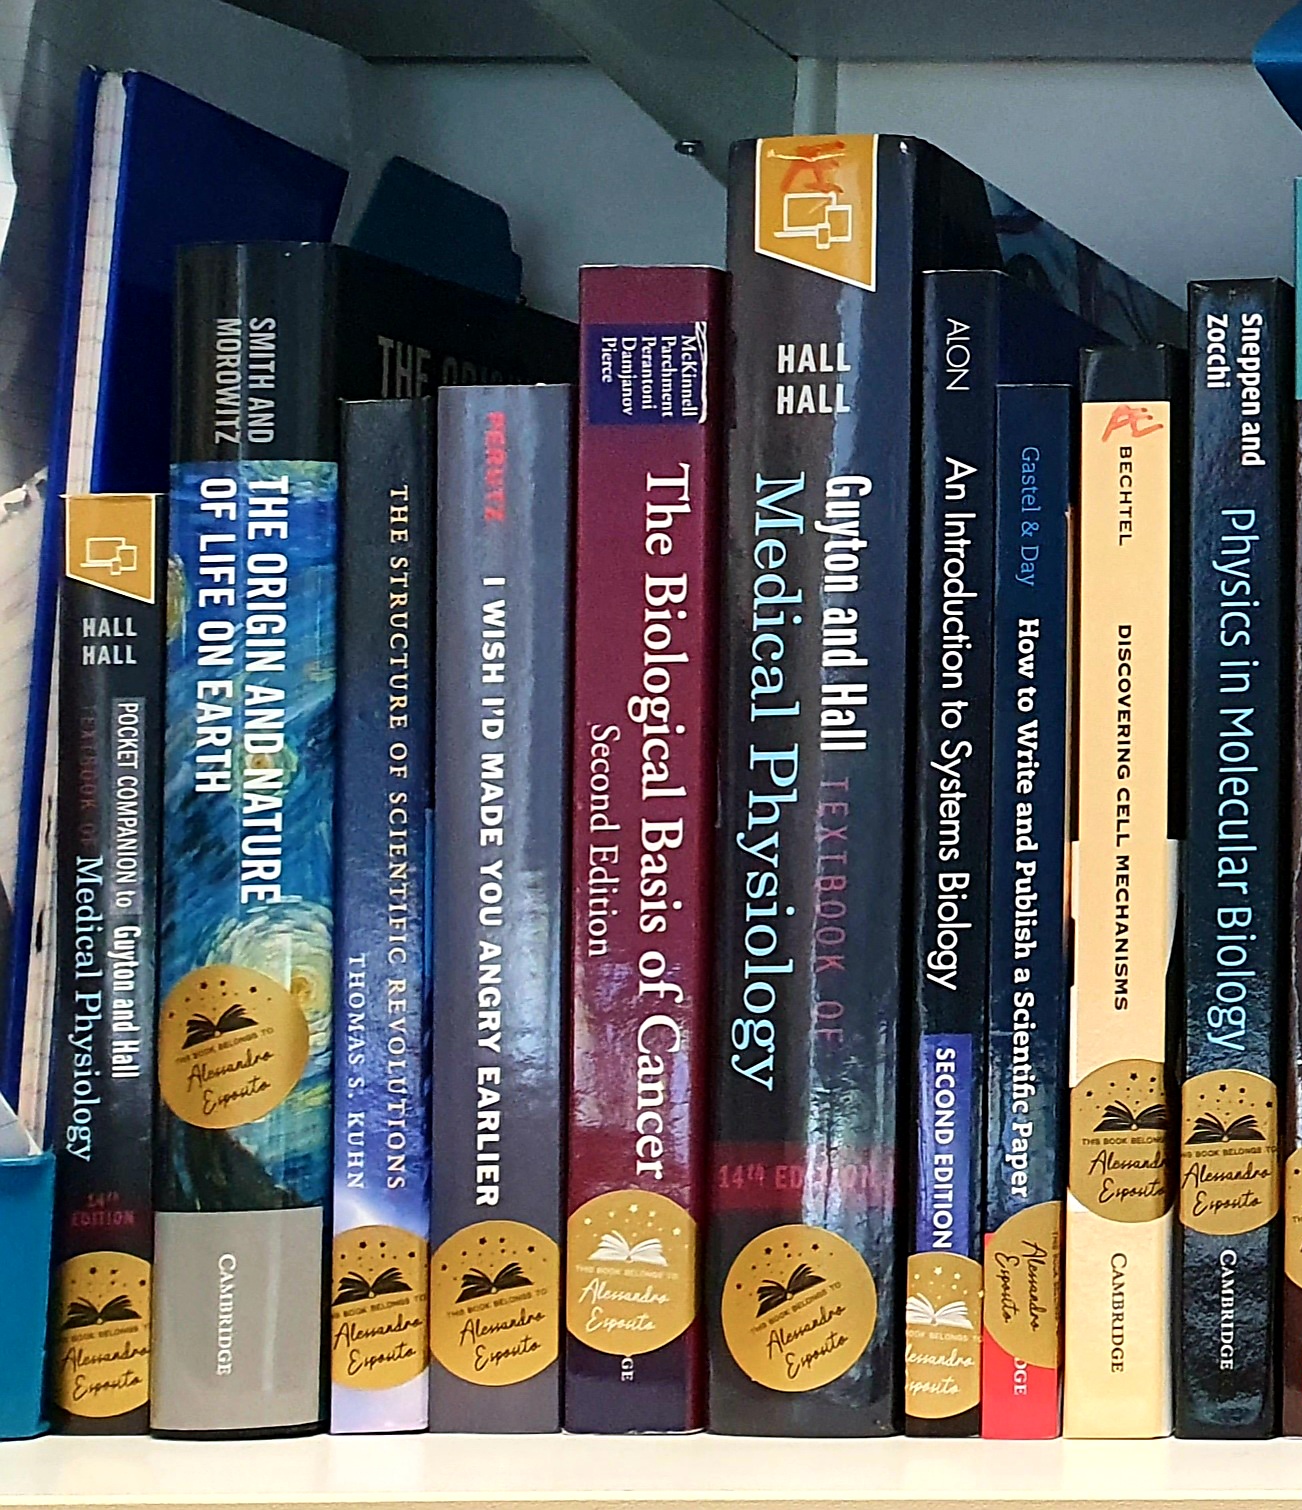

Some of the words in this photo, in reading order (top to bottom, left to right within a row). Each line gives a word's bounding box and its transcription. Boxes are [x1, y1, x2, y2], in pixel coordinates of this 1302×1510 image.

[214, 317, 241, 444] MOROWITZ
[249, 316, 275, 389] SMITH
[600, 337, 617, 383] Pierce
[617, 337, 638, 416] Damjanov
[641, 336, 656, 409] Perantoni
[661, 335, 677, 418] Parchment
[681, 334, 699, 417] McKinnell
[777, 343, 851, 373] HALL
[946, 318, 971, 392] ALON
[1205, 314, 1228, 389] Zocchi
[1238, 313, 1264, 415] Sneppen
[249, 394, 273, 443] AND
[776, 383, 851, 414] HALL
[1020, 446, 1041, 509] Gastel
[1240, 423, 1266, 465] and
[201, 476, 236, 524] OF
[246, 476, 288, 538] THE
[389, 484, 409, 543] THE
[813, 474, 872, 593] Guyton
[1020, 519, 1039, 536] &
[1117, 446, 1132, 547] BECHTEL
[198, 534, 235, 610] LIFE
[482, 577, 504, 586] I
[750, 472, 806, 723] Medical
[1019, 545, 1039, 588] Day
[1213, 509, 1258, 647] Physics
[82, 618, 137, 638] HALL
[197, 620, 234, 667] ON
[244, 546, 287, 671] ORIGIN
[389, 555, 408, 701] STRUCTURE
[481, 593, 505, 686] WISH
[821, 607, 869, 671] and
[82, 645, 137, 665] HALL
[1221, 659, 1258, 693] in
[116, 702, 138, 770] POCKET
[195, 680, 233, 793] EARTH
[244, 683, 285, 754] AND
[819, 681, 868, 752] Hall
[388, 741, 407, 780] OF
[115, 774, 138, 884] COMPANION
[241, 769, 284, 904] NATURE
[478, 751, 502, 848] MADE
[1215, 709, 1258, 896] Molecular
[116, 890, 133, 909] to
[386, 792, 408, 965] SCIENTIFIC
[477, 859, 502, 927] YOU
[74, 855, 104, 984] Medical
[730, 744, 798, 1091] Physiology
[107, 925, 141, 989] Guyton
[1207, 906, 1256, 1053] Biology
[112, 996, 140, 1034] and
[348, 953, 365, 1065] THOMAS
[477, 938, 501, 1054] ANGRY
[66, 990, 102, 1163] Physiology
[111, 1039, 140, 1079] Hall
[348, 1076, 365, 1098] S.
[386, 976, 406, 1189] REVOLUTIONS
[935, 1047, 956, 1145] SECOND
[348, 1105, 364, 1189] KUHN
[476, 1065, 500, 1207] EARLIER
[934, 1155, 953, 1249] EDITION
[217, 1254, 236, 1376] CAMBRIDGE
[1109, 1252, 1127, 1373] CAMBRIDGE
[1219, 1249, 1237, 1370] CAMBRIDGE
